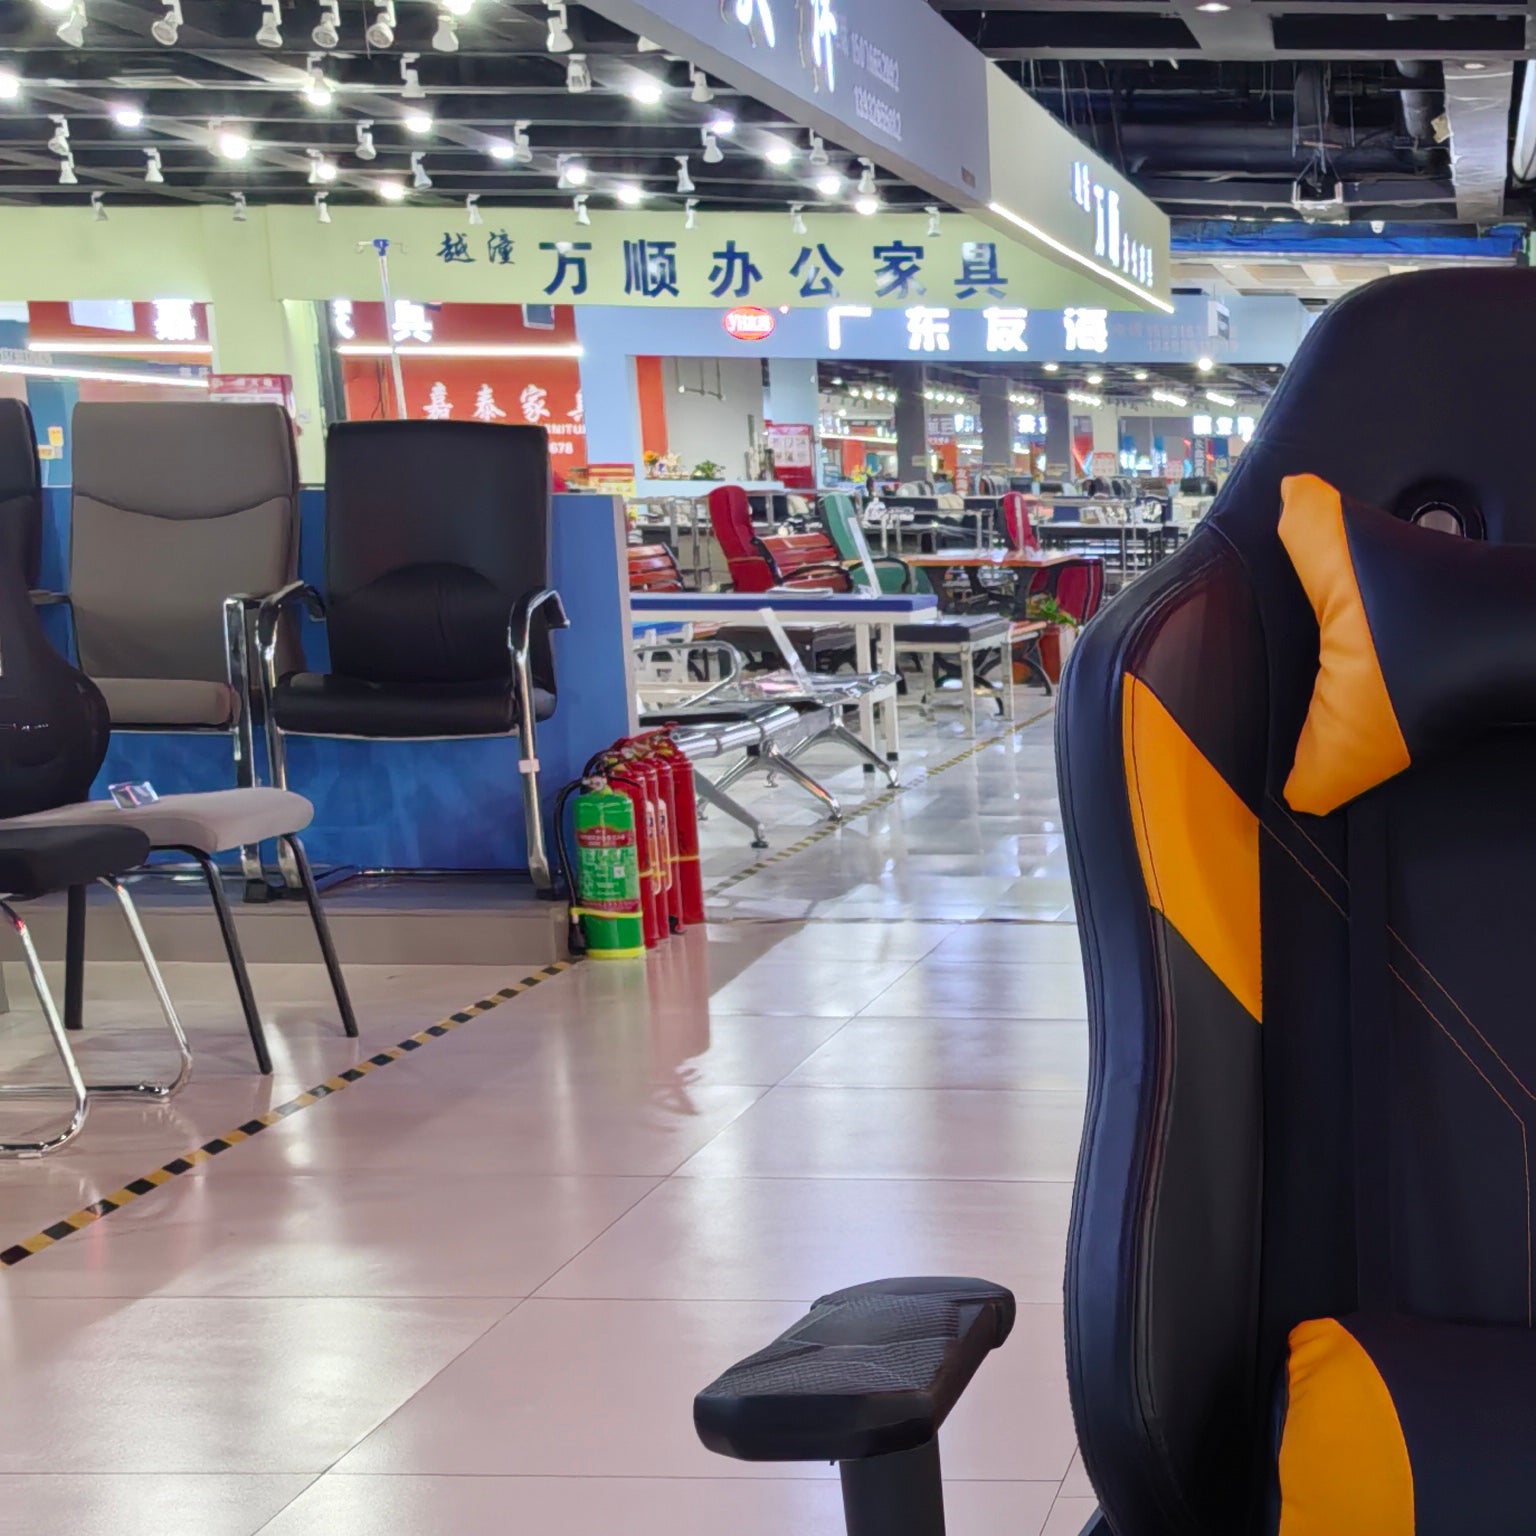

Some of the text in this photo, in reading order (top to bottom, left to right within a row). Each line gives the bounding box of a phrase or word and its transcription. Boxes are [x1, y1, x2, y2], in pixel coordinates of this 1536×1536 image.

[538, 236, 1009, 299] 万顺办公家具
